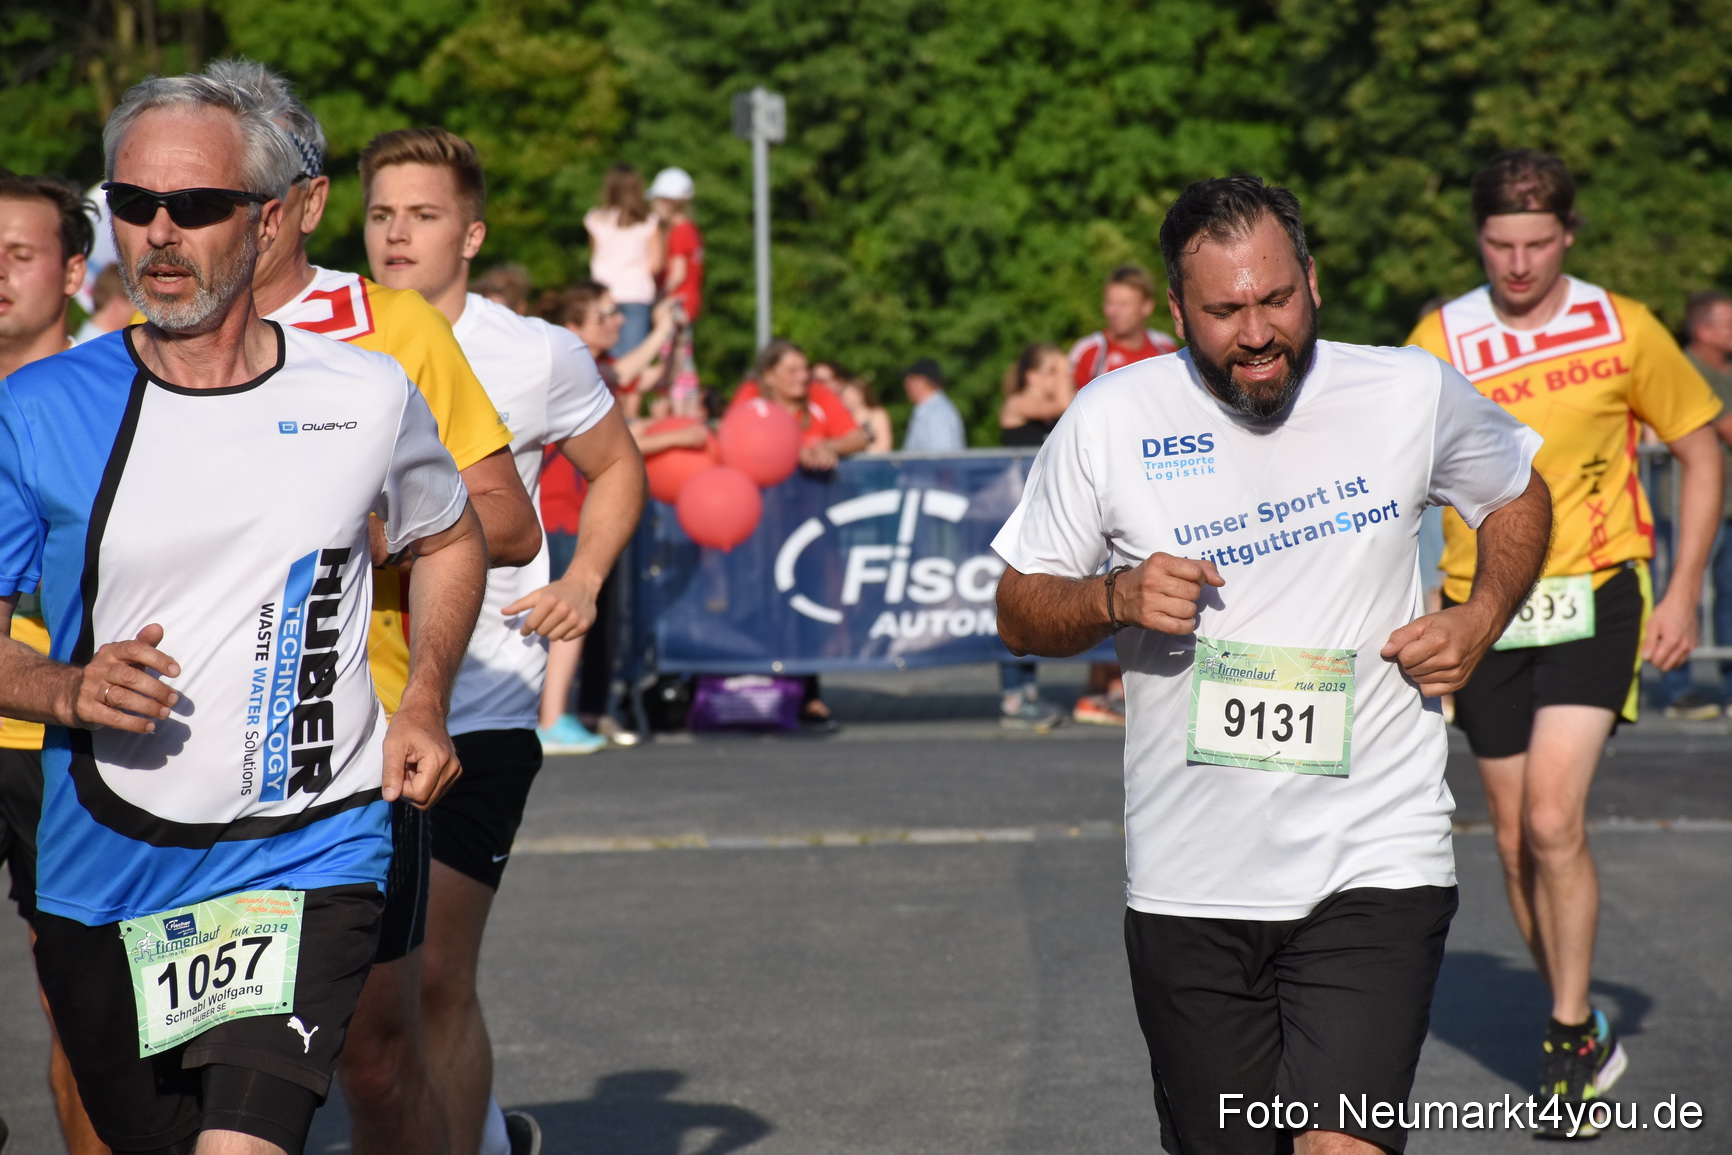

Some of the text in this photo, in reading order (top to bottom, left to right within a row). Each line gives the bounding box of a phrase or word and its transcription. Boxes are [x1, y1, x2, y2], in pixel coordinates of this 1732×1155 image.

[1481, 355, 1631, 405] AX BÖGL
[1141, 433, 1215, 458] DESS
[1144, 455, 1215, 470] Transporte
[1146, 465, 1216, 481] Logistik
[1173, 476, 1370, 547] Unser Sport ist
[1184, 499, 1400, 568] üttguttranSport
[840, 545, 1000, 606] Fisc
[868, 608, 998, 640] AUTOM
[287, 546, 352, 801] HUBER
[1218, 662, 1277, 680] firmenlauf
[1318, 682, 1346, 692] 2019
[240, 602, 276, 797] WASTE WATER Solutions
[265, 601, 305, 791] TECHNOLOGY
[1223, 698, 1315, 744] 9131
[155, 924, 222, 954] firmenlauf
[253, 923, 289, 934] 2019
[157, 935, 273, 1010] 1057
[165, 984, 264, 1026] Schnabl Wolfgang
[192, 1007, 216, 1025] HUBER
[216, 1002, 227, 1016] SE
